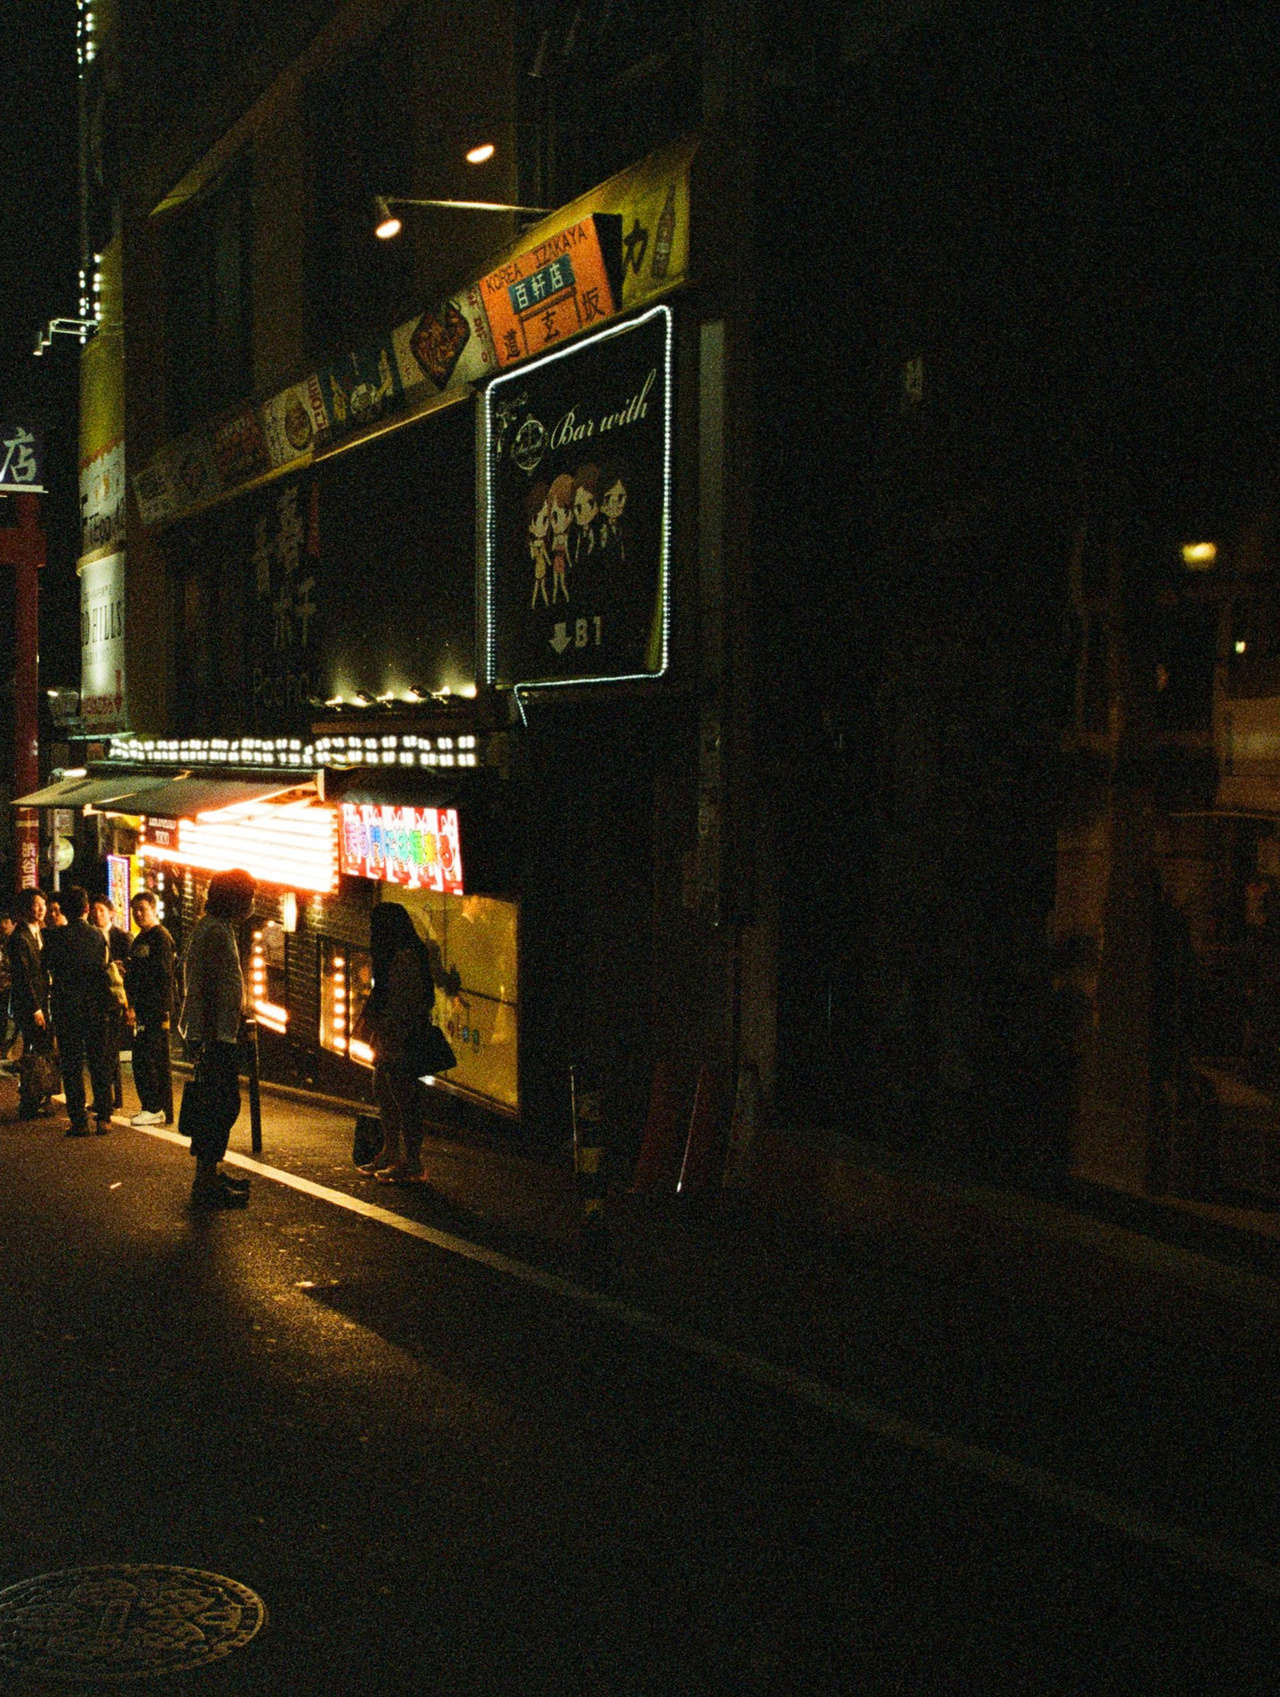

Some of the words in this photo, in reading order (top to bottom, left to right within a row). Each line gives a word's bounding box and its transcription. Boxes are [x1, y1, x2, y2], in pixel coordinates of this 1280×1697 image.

[486, 262, 524, 295] KOREA
[533, 223, 589, 269] IZAKAYA
[514, 262, 565, 310] 百軒店
[550, 403, 594, 450] Bar
[599, 368, 657, 433] with
[575, 615, 603, 649] B1
